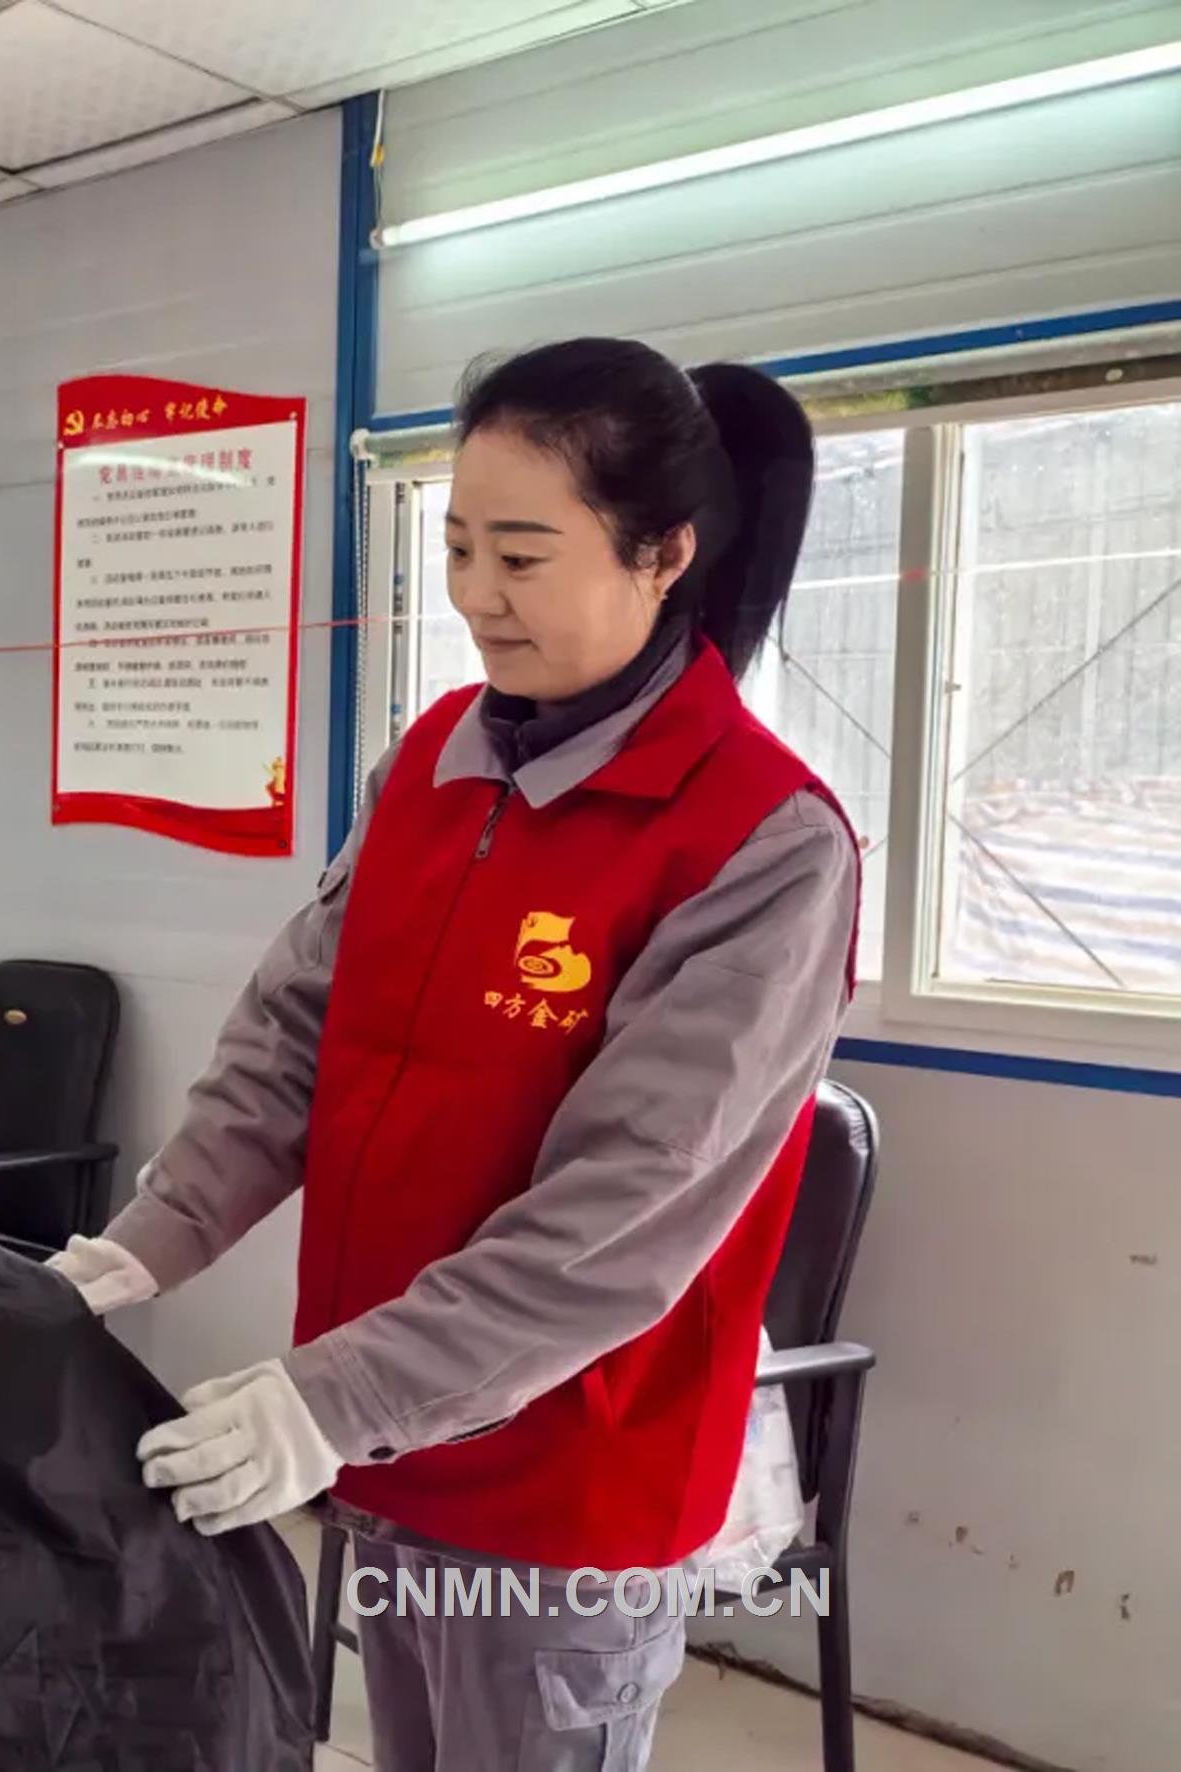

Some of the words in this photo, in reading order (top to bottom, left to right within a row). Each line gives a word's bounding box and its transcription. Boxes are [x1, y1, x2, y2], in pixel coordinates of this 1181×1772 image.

[164, 395, 228, 422] 牢记使命
[484, 990, 589, 1035] 四方金矿
